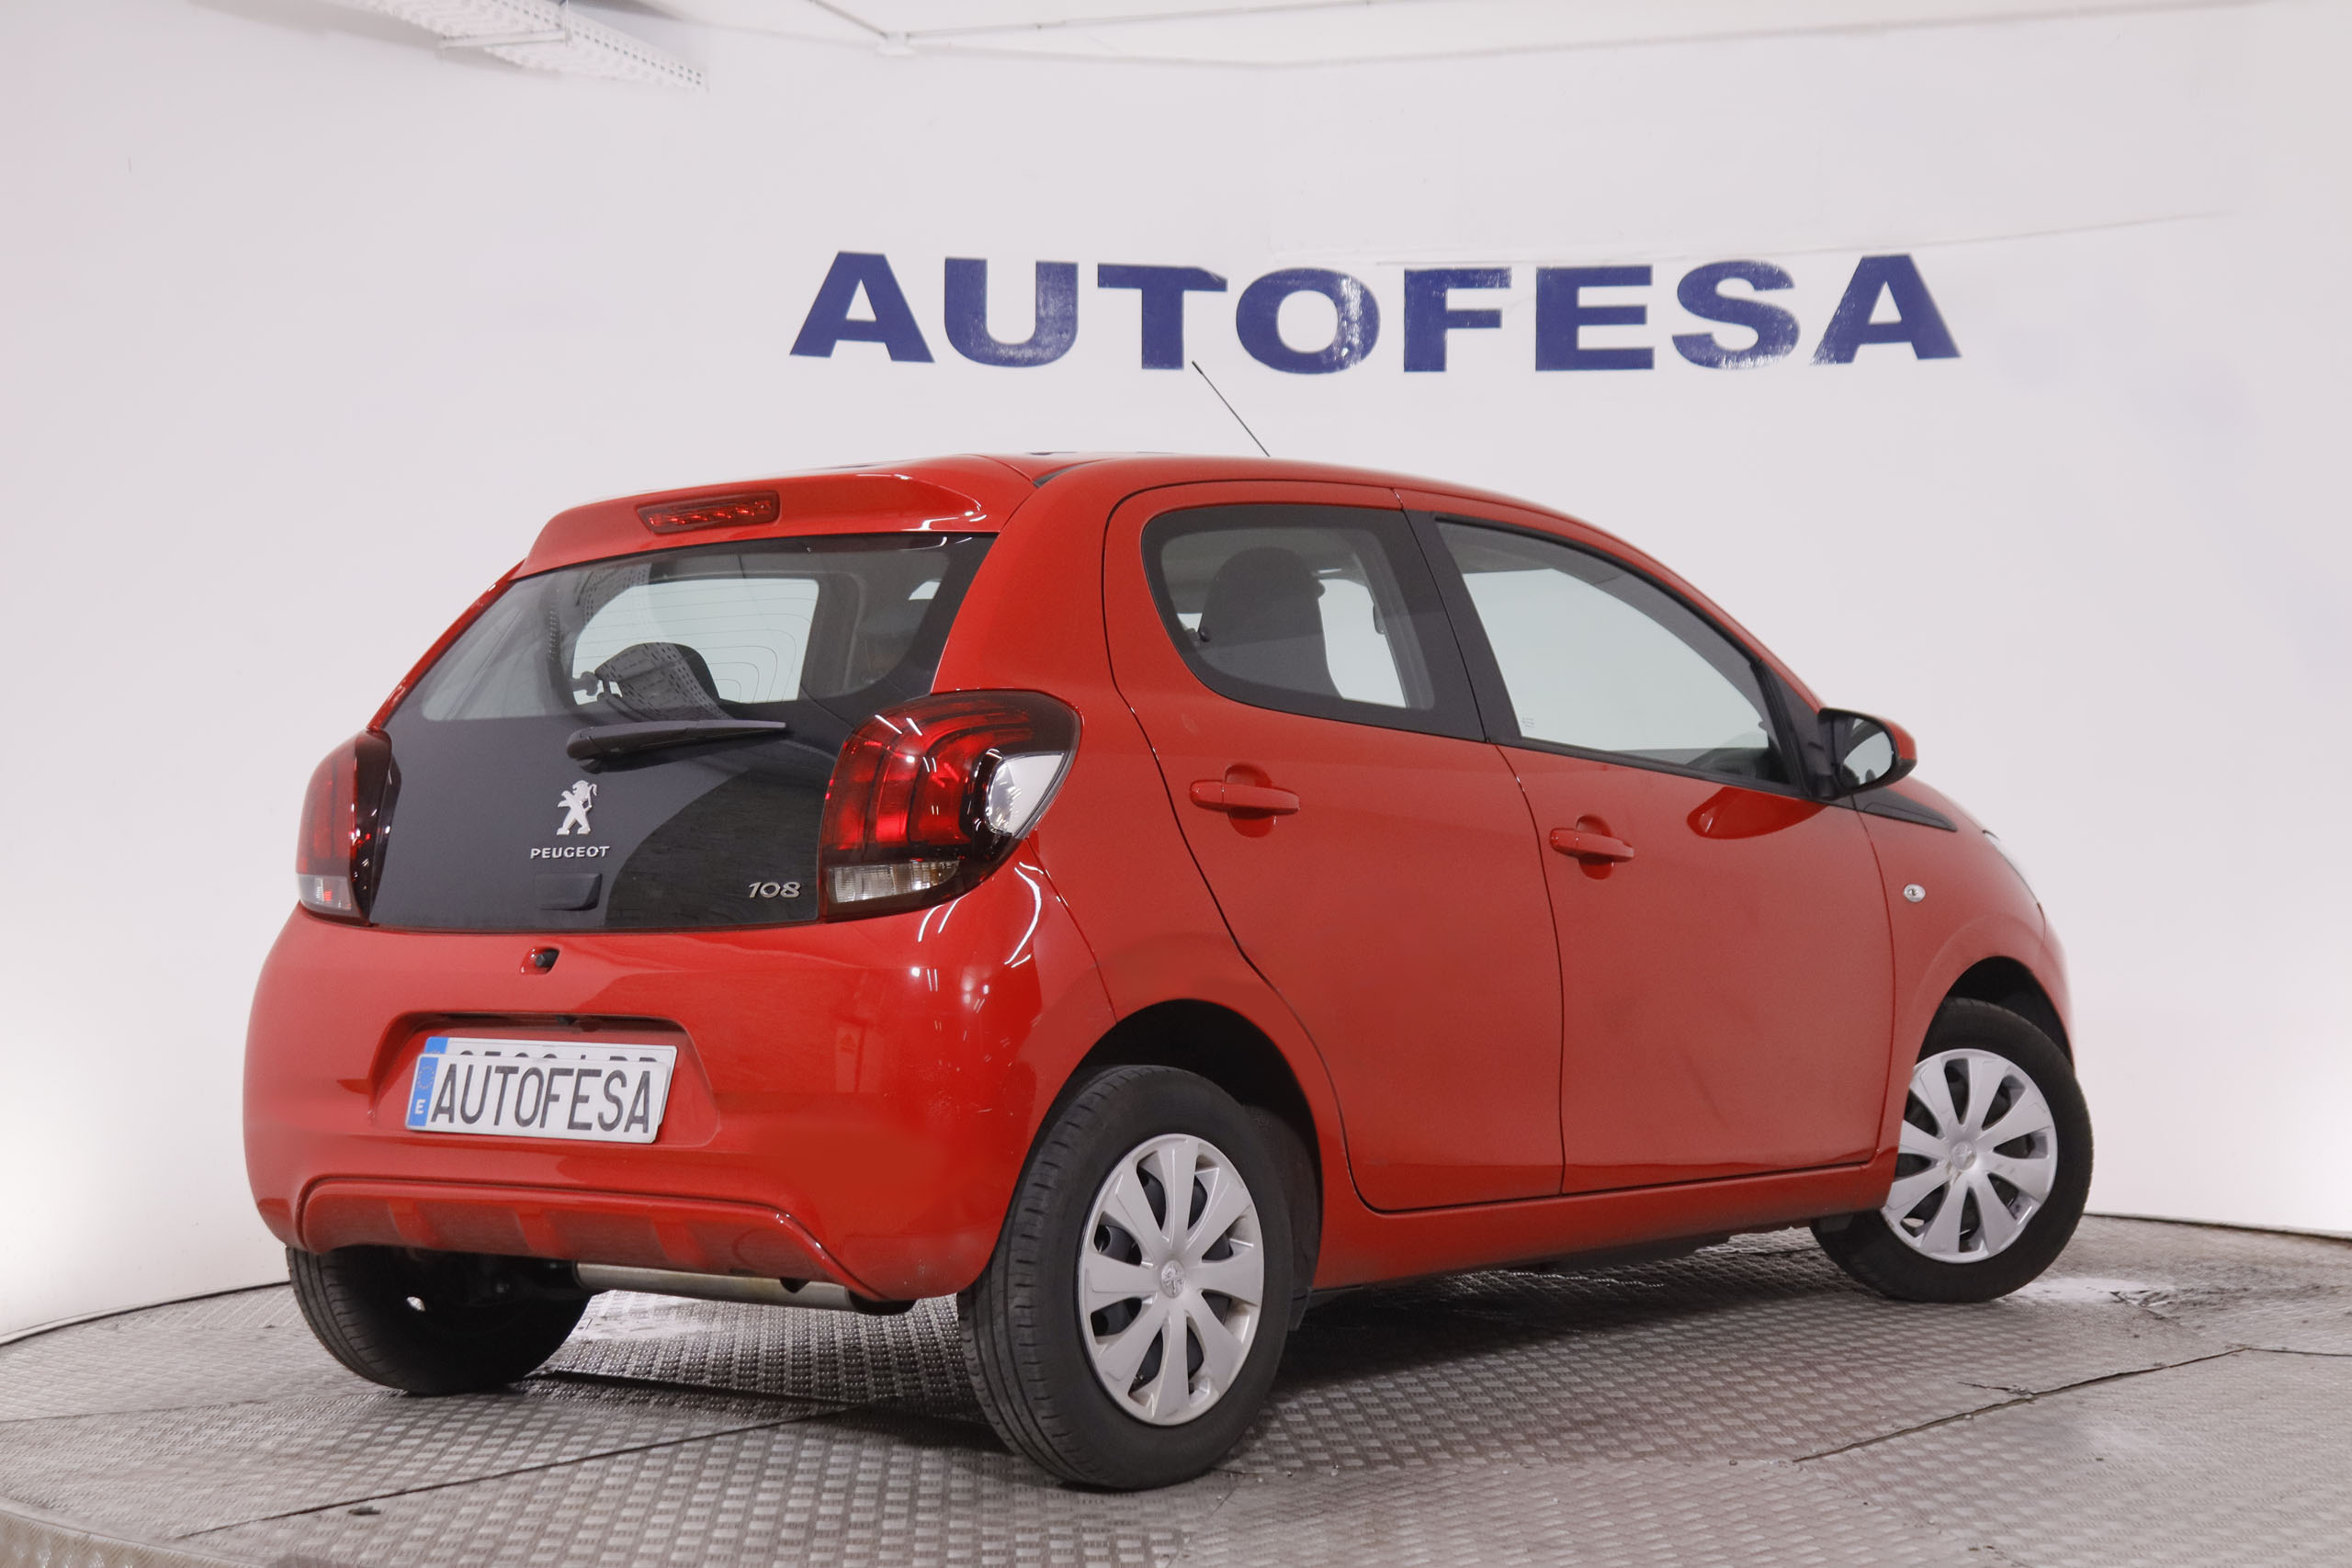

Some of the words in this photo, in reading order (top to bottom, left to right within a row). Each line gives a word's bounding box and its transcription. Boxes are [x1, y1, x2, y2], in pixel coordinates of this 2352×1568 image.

[789, 250, 1962, 374] AUTOFESA
[530, 846, 610, 859] PEUGEOT
[748, 881, 802, 898] 108
[414, 1099, 426, 1115] E
[430, 1063, 651, 1134] AUTOFESA
